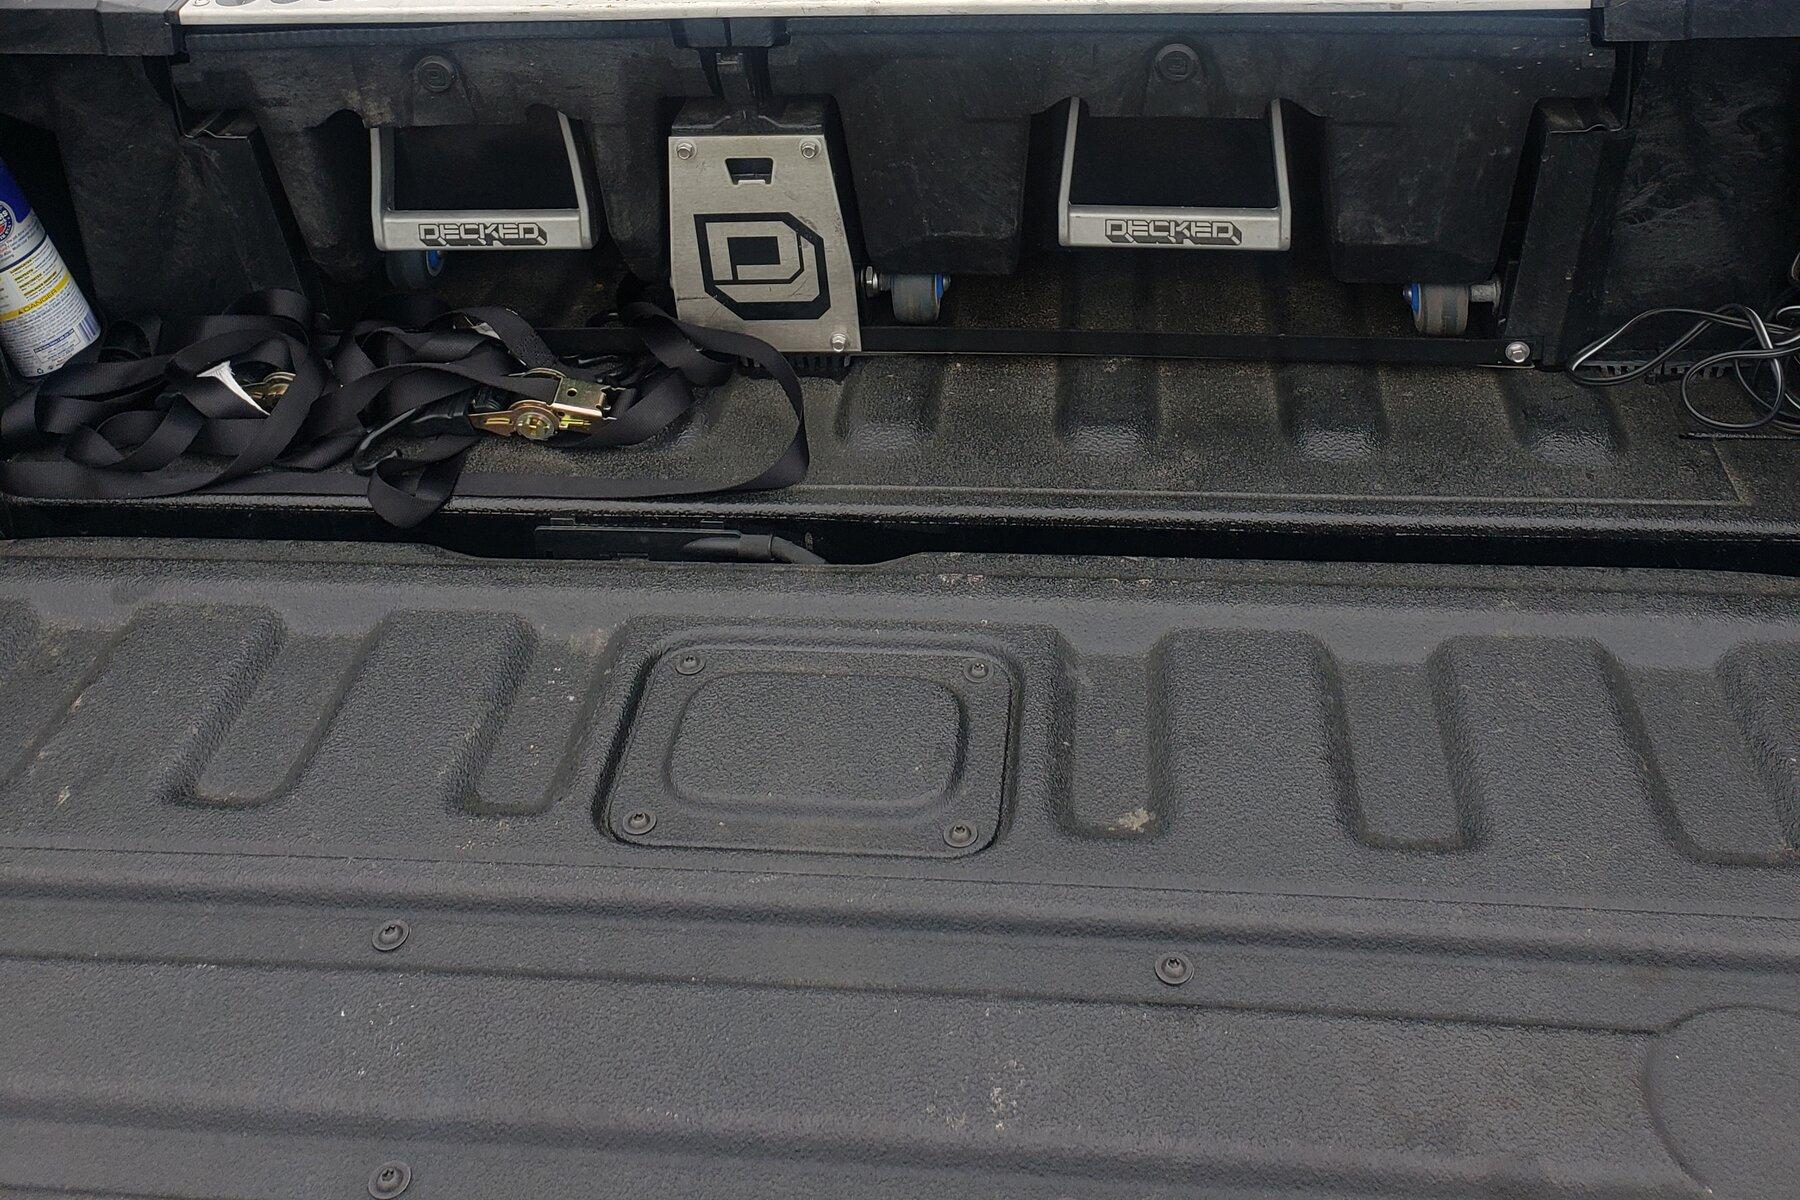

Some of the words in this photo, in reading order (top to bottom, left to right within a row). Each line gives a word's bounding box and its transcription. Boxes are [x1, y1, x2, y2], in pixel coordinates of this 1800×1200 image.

[418, 222, 547, 246] DECKED
[1105, 219, 1242, 246] DECKED
[24, 288, 57, 312] DANGER
